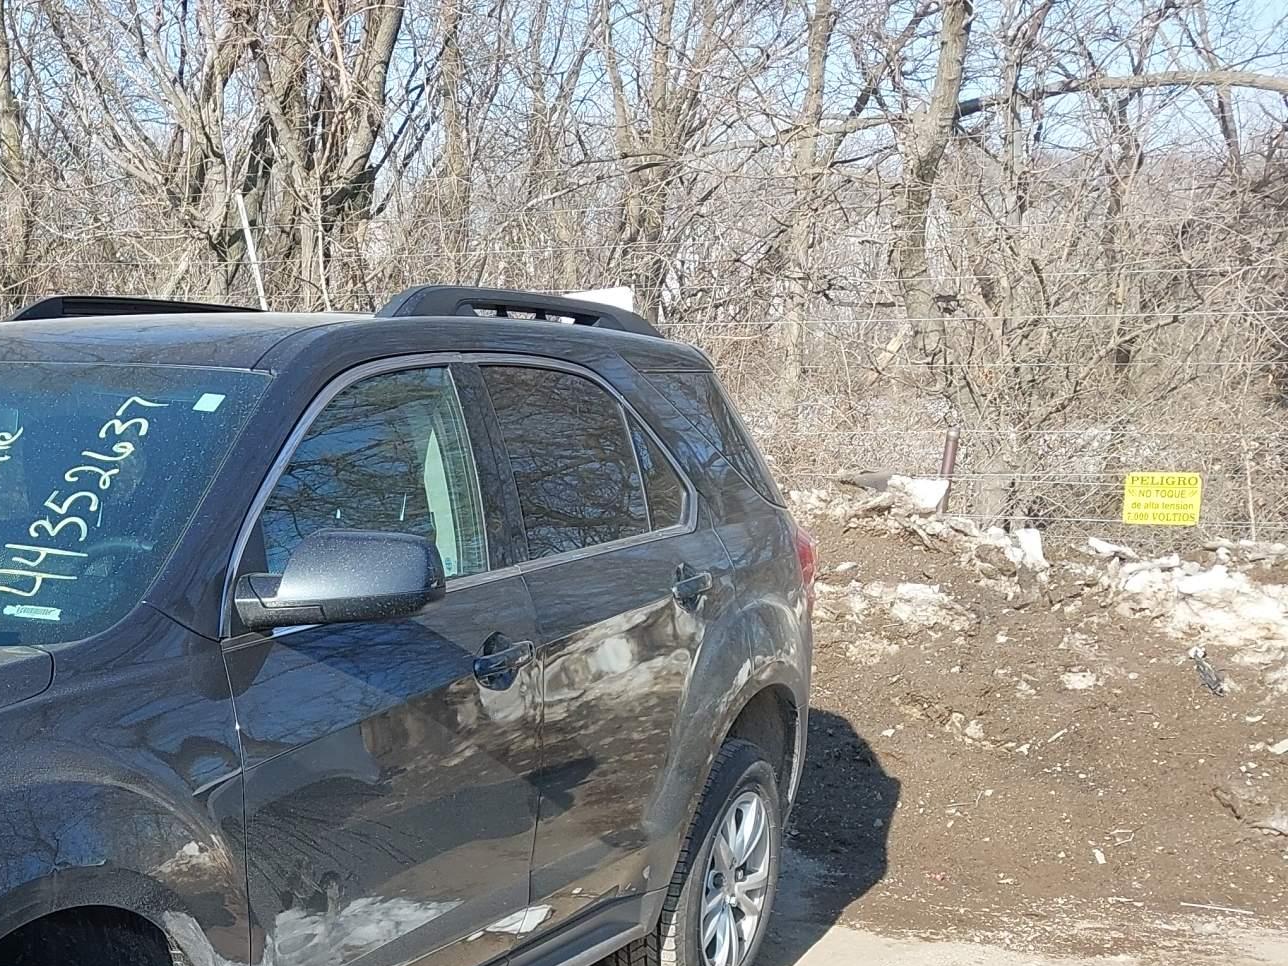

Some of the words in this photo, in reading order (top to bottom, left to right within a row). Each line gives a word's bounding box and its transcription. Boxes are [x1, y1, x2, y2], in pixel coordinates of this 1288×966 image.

[1130, 476, 1199, 486] PELIGRO
[1138, 489, 1152, 498] NO
[1155, 489, 1187, 498] TOQUE
[1152, 512, 1196, 521] VOLTIOS
